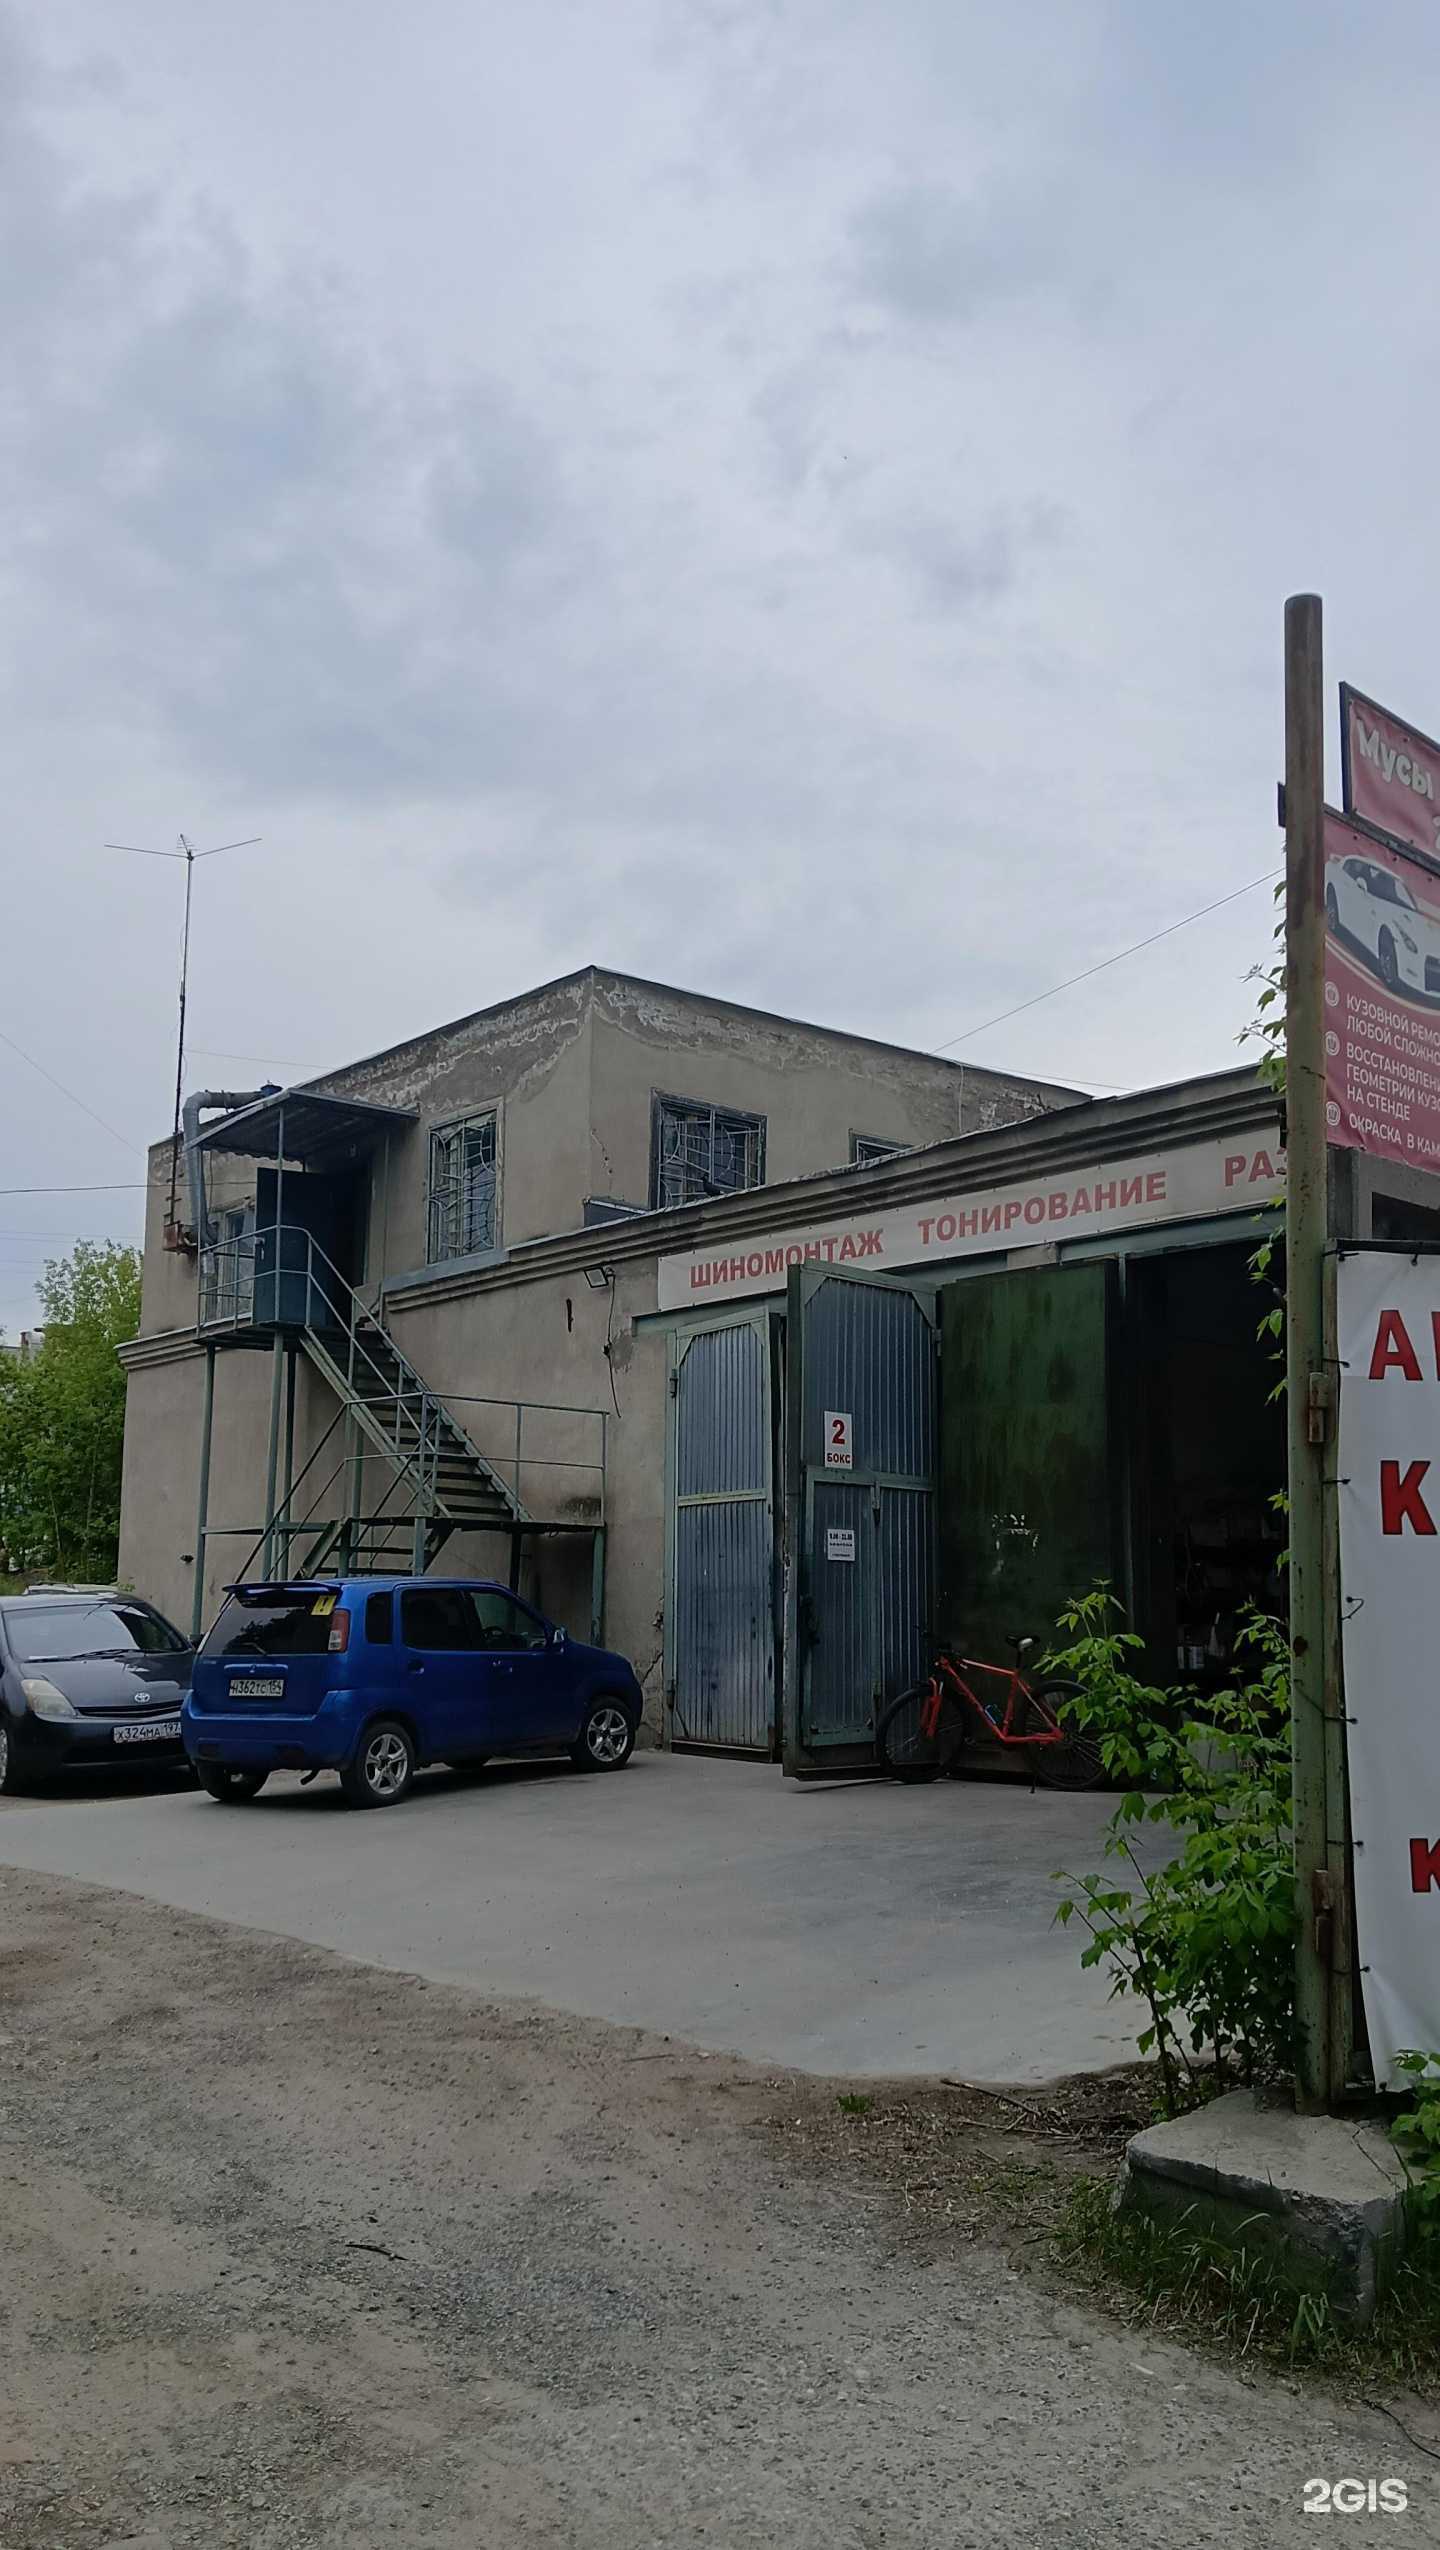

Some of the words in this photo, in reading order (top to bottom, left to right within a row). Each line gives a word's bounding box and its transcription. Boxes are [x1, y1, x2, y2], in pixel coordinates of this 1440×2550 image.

[1357, 719, 1434, 801] Мусы
[1346, 993, 1409, 1034] КУЗОВНОЙ
[1346, 1015, 1392, 1046] ЛЮБОЙ
[1346, 1063, 1415, 1104] ГЕОМЕТРИИ
[1346, 1083, 1364, 1105] НА
[1366, 1091, 1410, 1121] СТЕНДЕ
[1349, 1113, 1402, 1145] ОКРАСКА
[1407, 1132, 1415, 1149] В
[690, 1228, 884, 1288] ШИНОМОНТАЖ
[917, 1171, 1167, 1245] ТОНИРОВАНИЕ
[1224, 1146, 1288, 1187] РА
[832, 1419, 845, 1444] 2
[827, 1452, 850, 1464] БОКС
